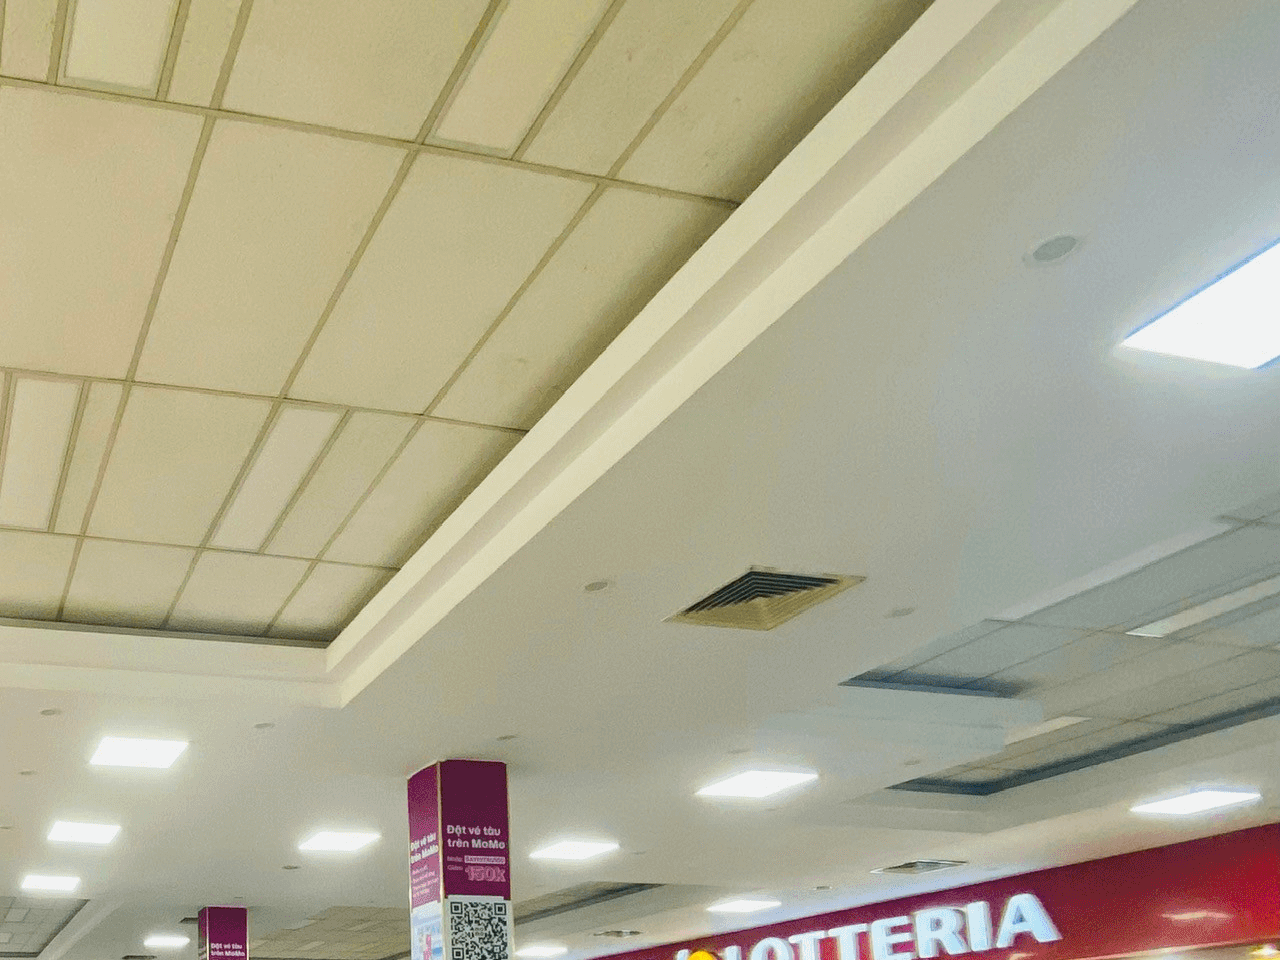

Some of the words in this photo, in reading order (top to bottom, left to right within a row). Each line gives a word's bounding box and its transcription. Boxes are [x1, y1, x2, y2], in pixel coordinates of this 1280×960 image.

[447, 825, 466, 837] Đặt
[468, 826, 481, 835] vé
[483, 826, 501, 836] tàu
[447, 838, 469, 848] trên
[472, 839, 506, 849] MoMo
